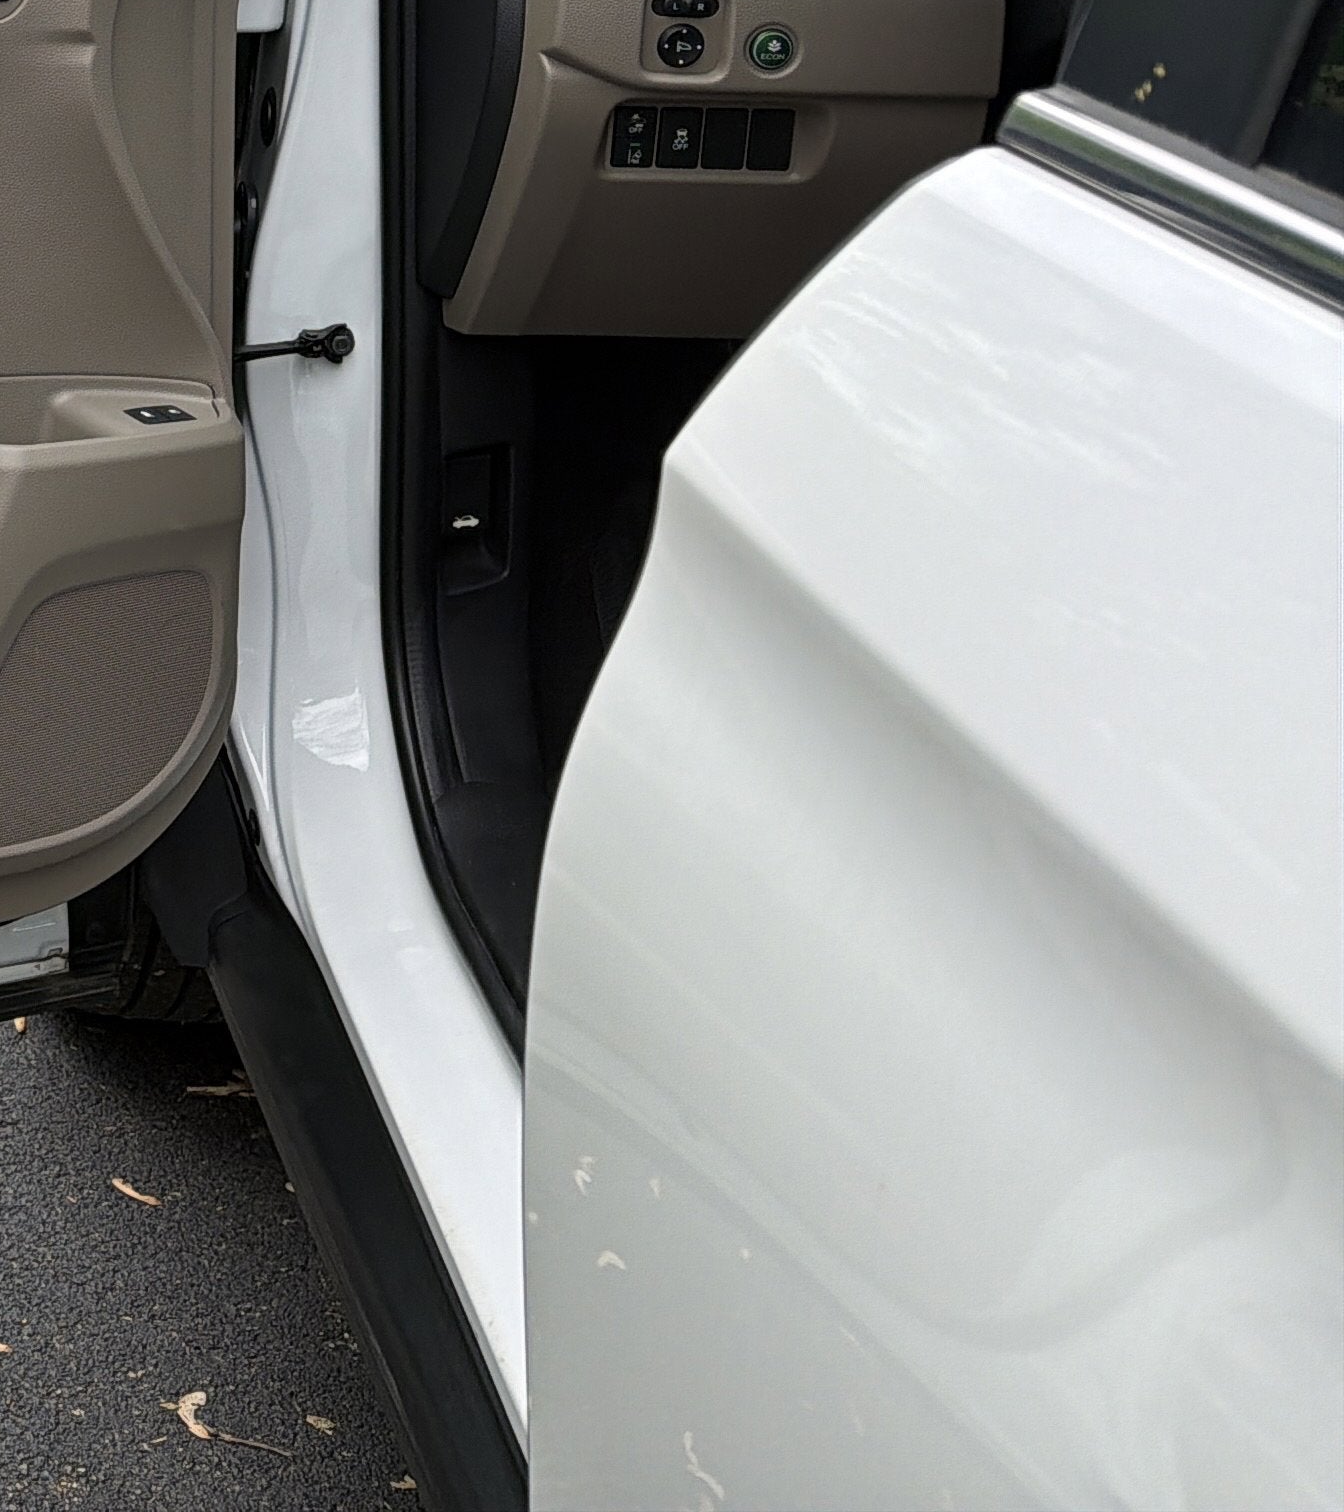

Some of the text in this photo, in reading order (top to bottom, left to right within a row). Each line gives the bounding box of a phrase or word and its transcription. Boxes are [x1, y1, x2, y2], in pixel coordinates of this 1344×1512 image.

[672, 3, 679, 11] L
[697, 3, 705, 11] R
[672, 143, 689, 151] OFF
